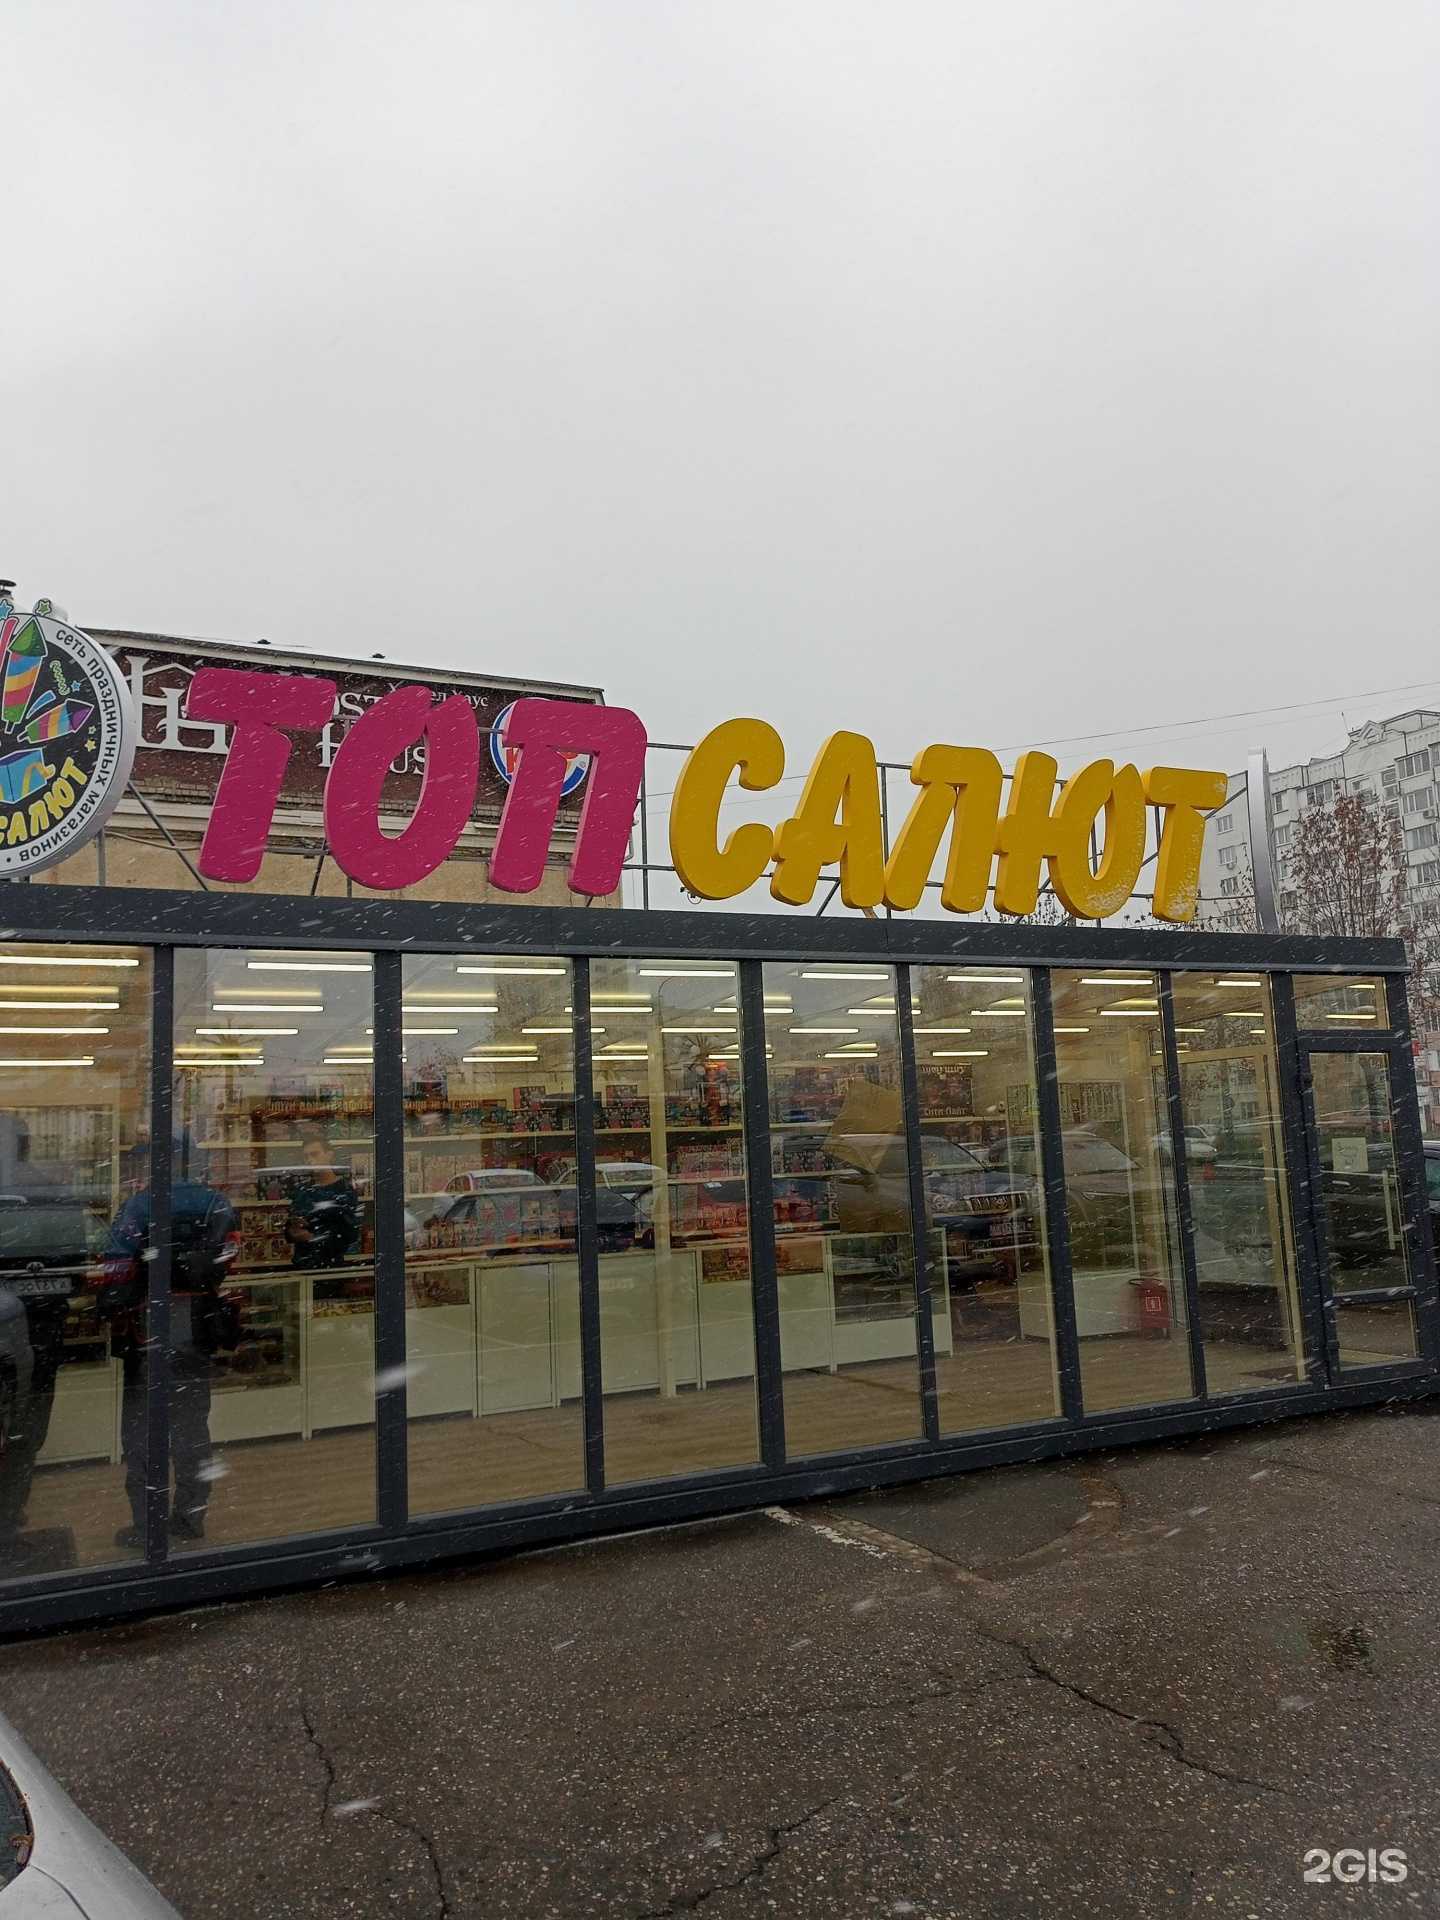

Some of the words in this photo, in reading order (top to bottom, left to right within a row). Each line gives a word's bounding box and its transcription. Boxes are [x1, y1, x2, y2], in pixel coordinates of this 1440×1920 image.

[55, 629, 87, 659] сеть
[87, 657, 118, 787] праздничных
[0, 756, 88, 846] АЛЮТ
[19, 790, 100, 862] магазинов
[186, 667, 648, 896] ТОП
[669, 718, 1228, 923] САЛЮТ
